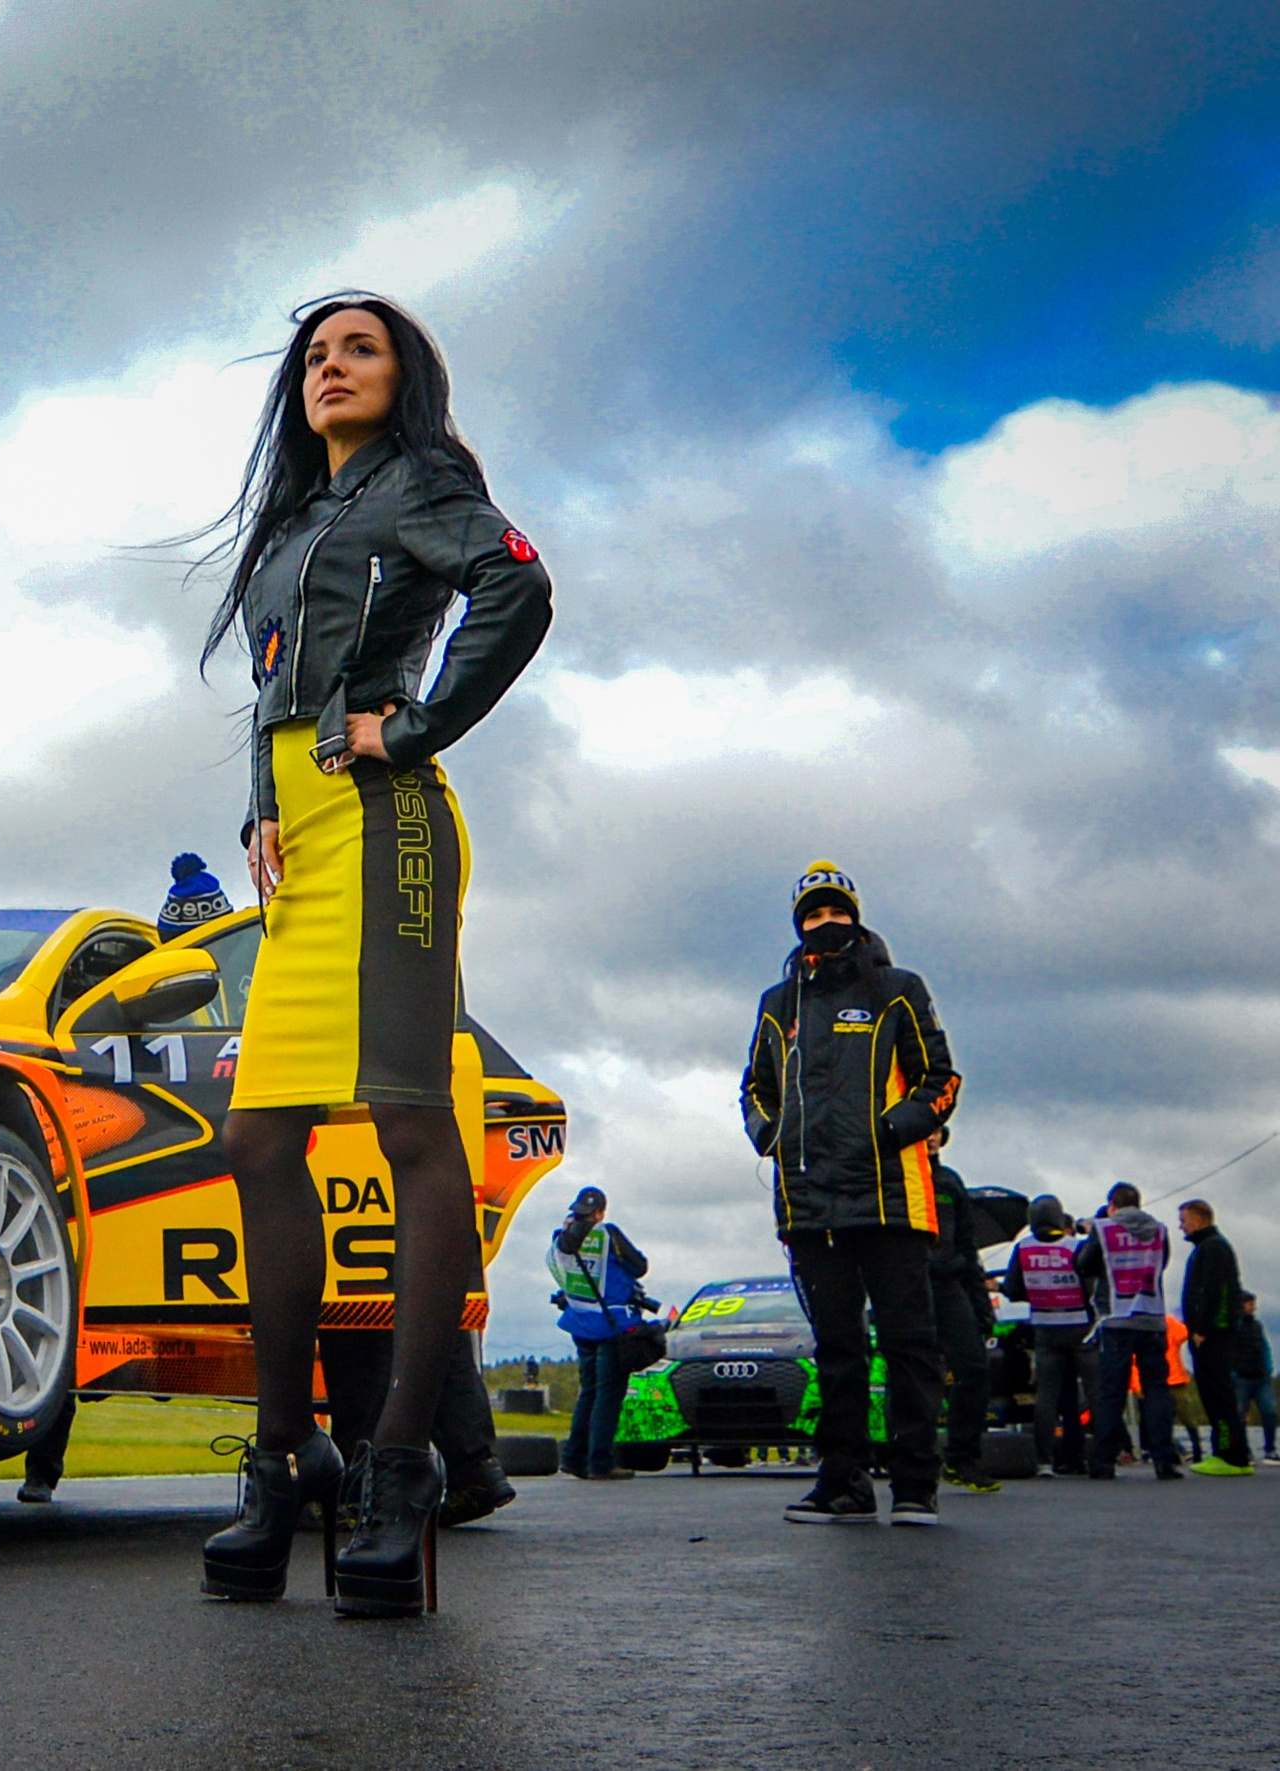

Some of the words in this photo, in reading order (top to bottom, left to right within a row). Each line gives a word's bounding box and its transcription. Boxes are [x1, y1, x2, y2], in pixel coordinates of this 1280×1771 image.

[89, 1034, 187, 1084] 11
[323, 1177, 391, 1214] DA
[680, 1296, 746, 1322] 89
